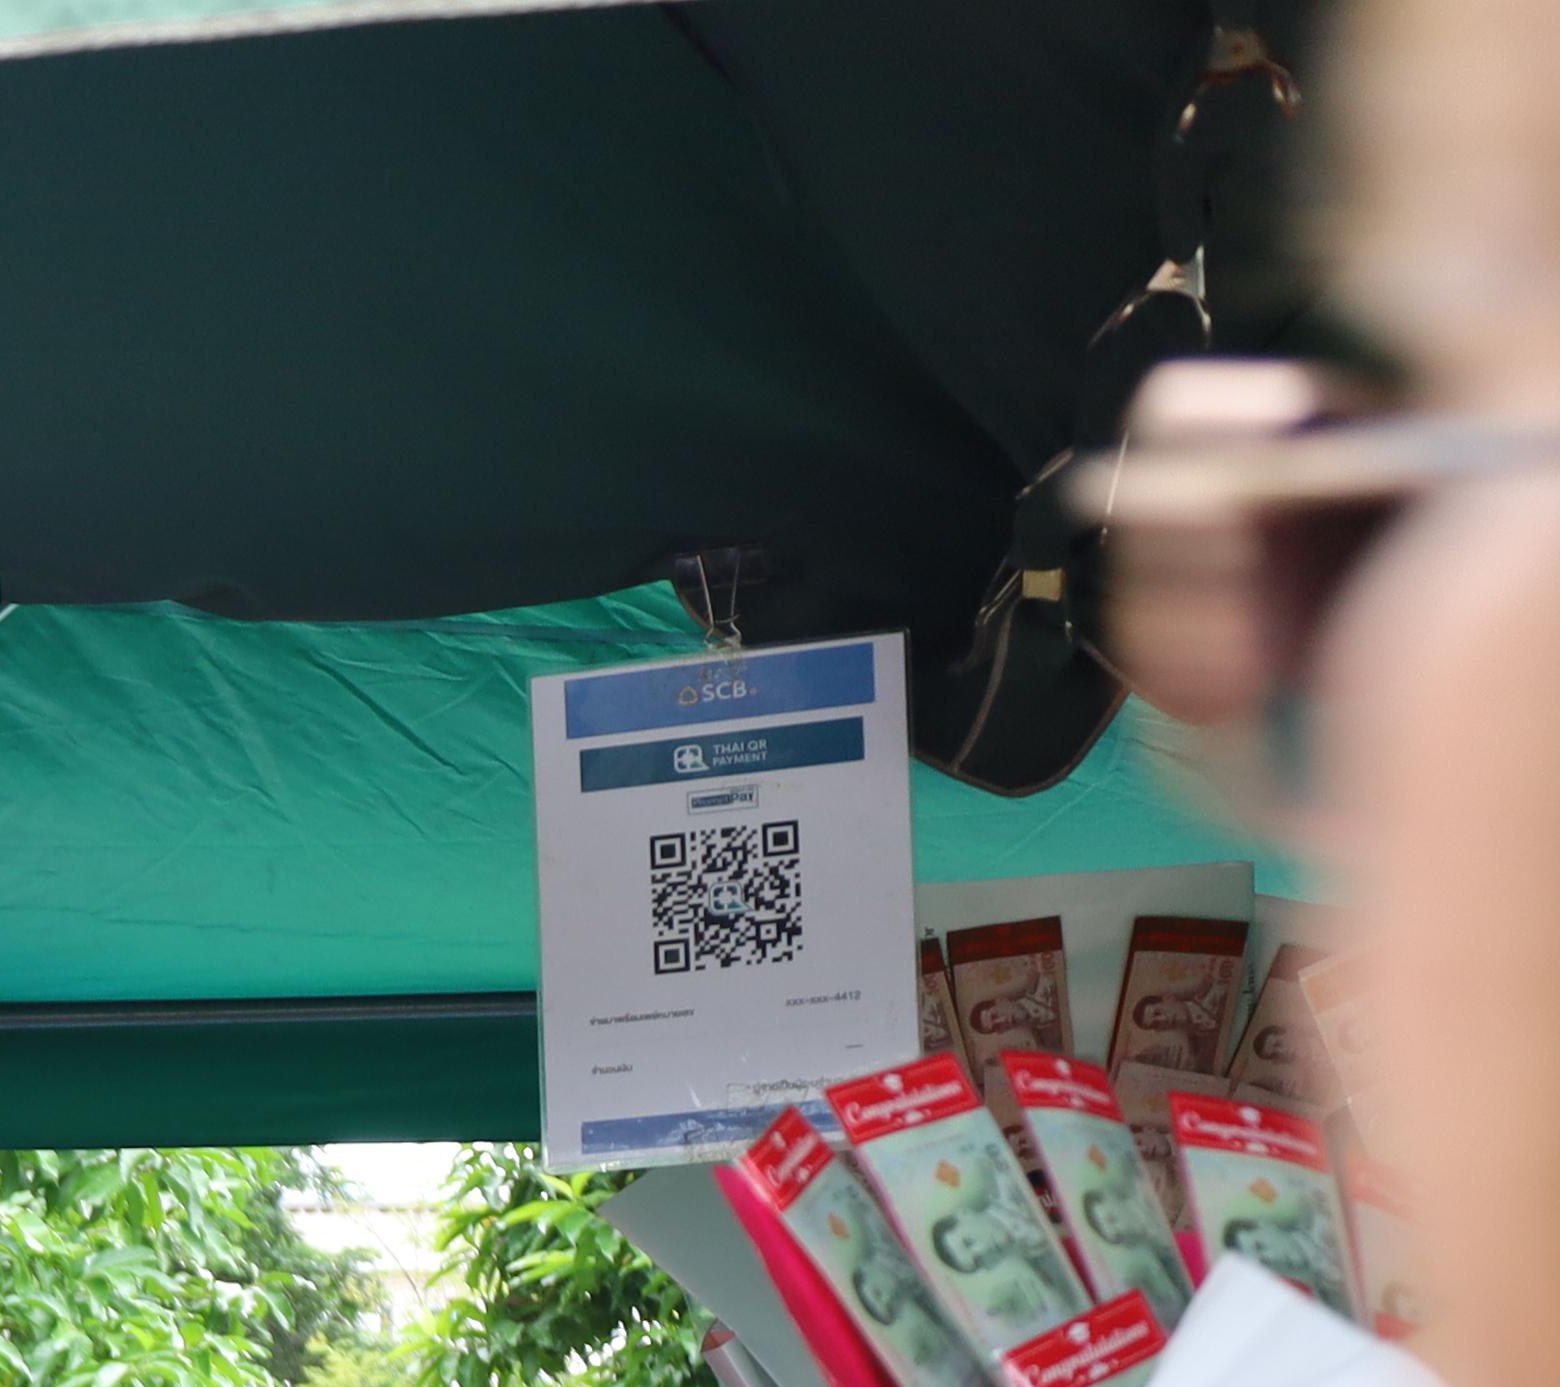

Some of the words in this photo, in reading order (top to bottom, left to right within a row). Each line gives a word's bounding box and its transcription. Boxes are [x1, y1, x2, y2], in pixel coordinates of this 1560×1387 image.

[702, 680, 747, 702] SCB
[713, 742, 744, 755] THAI
[748, 740, 767, 751] QR
[713, 752, 767, 766] PAYMENT
